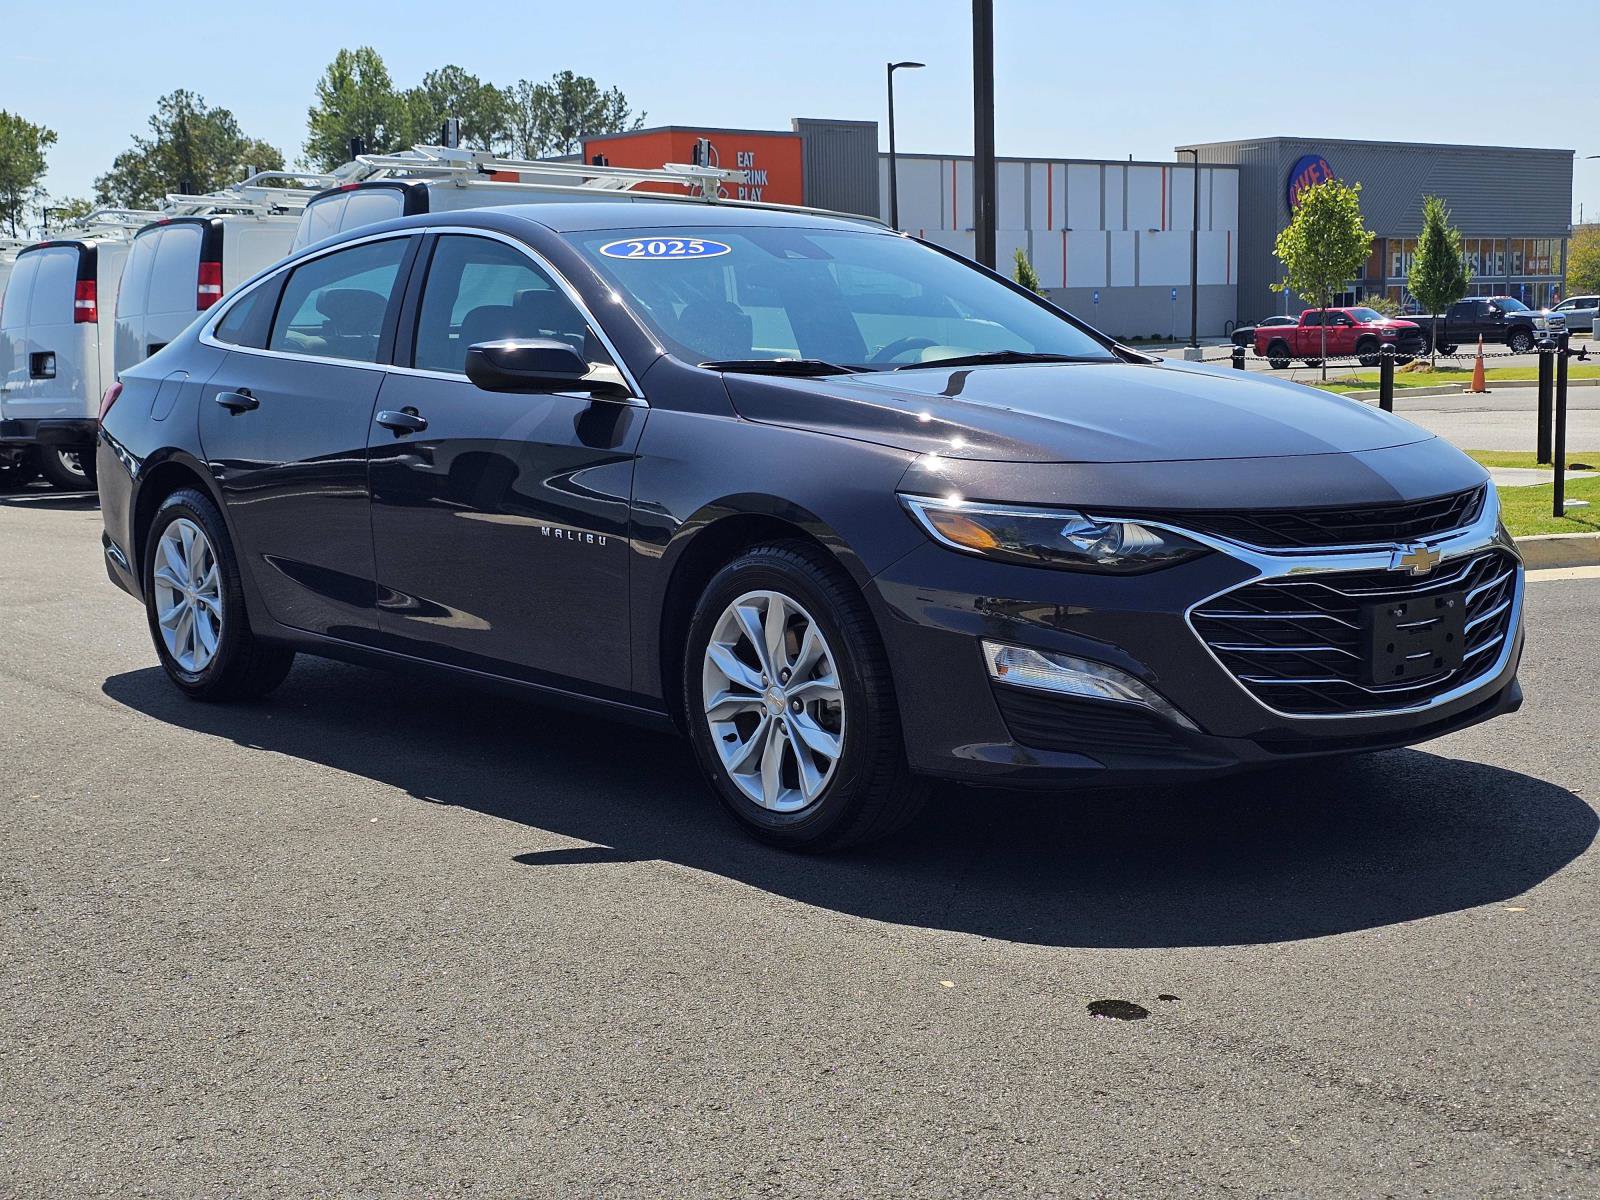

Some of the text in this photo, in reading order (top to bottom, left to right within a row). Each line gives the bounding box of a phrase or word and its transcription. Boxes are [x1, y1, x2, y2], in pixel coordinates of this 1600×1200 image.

[737, 152, 754, 167] EAT
[738, 169, 768, 185] RINK
[738, 187, 762, 201] PLAY
[627, 241, 705, 257] 2025
[541, 526, 606, 546] MALIBU
